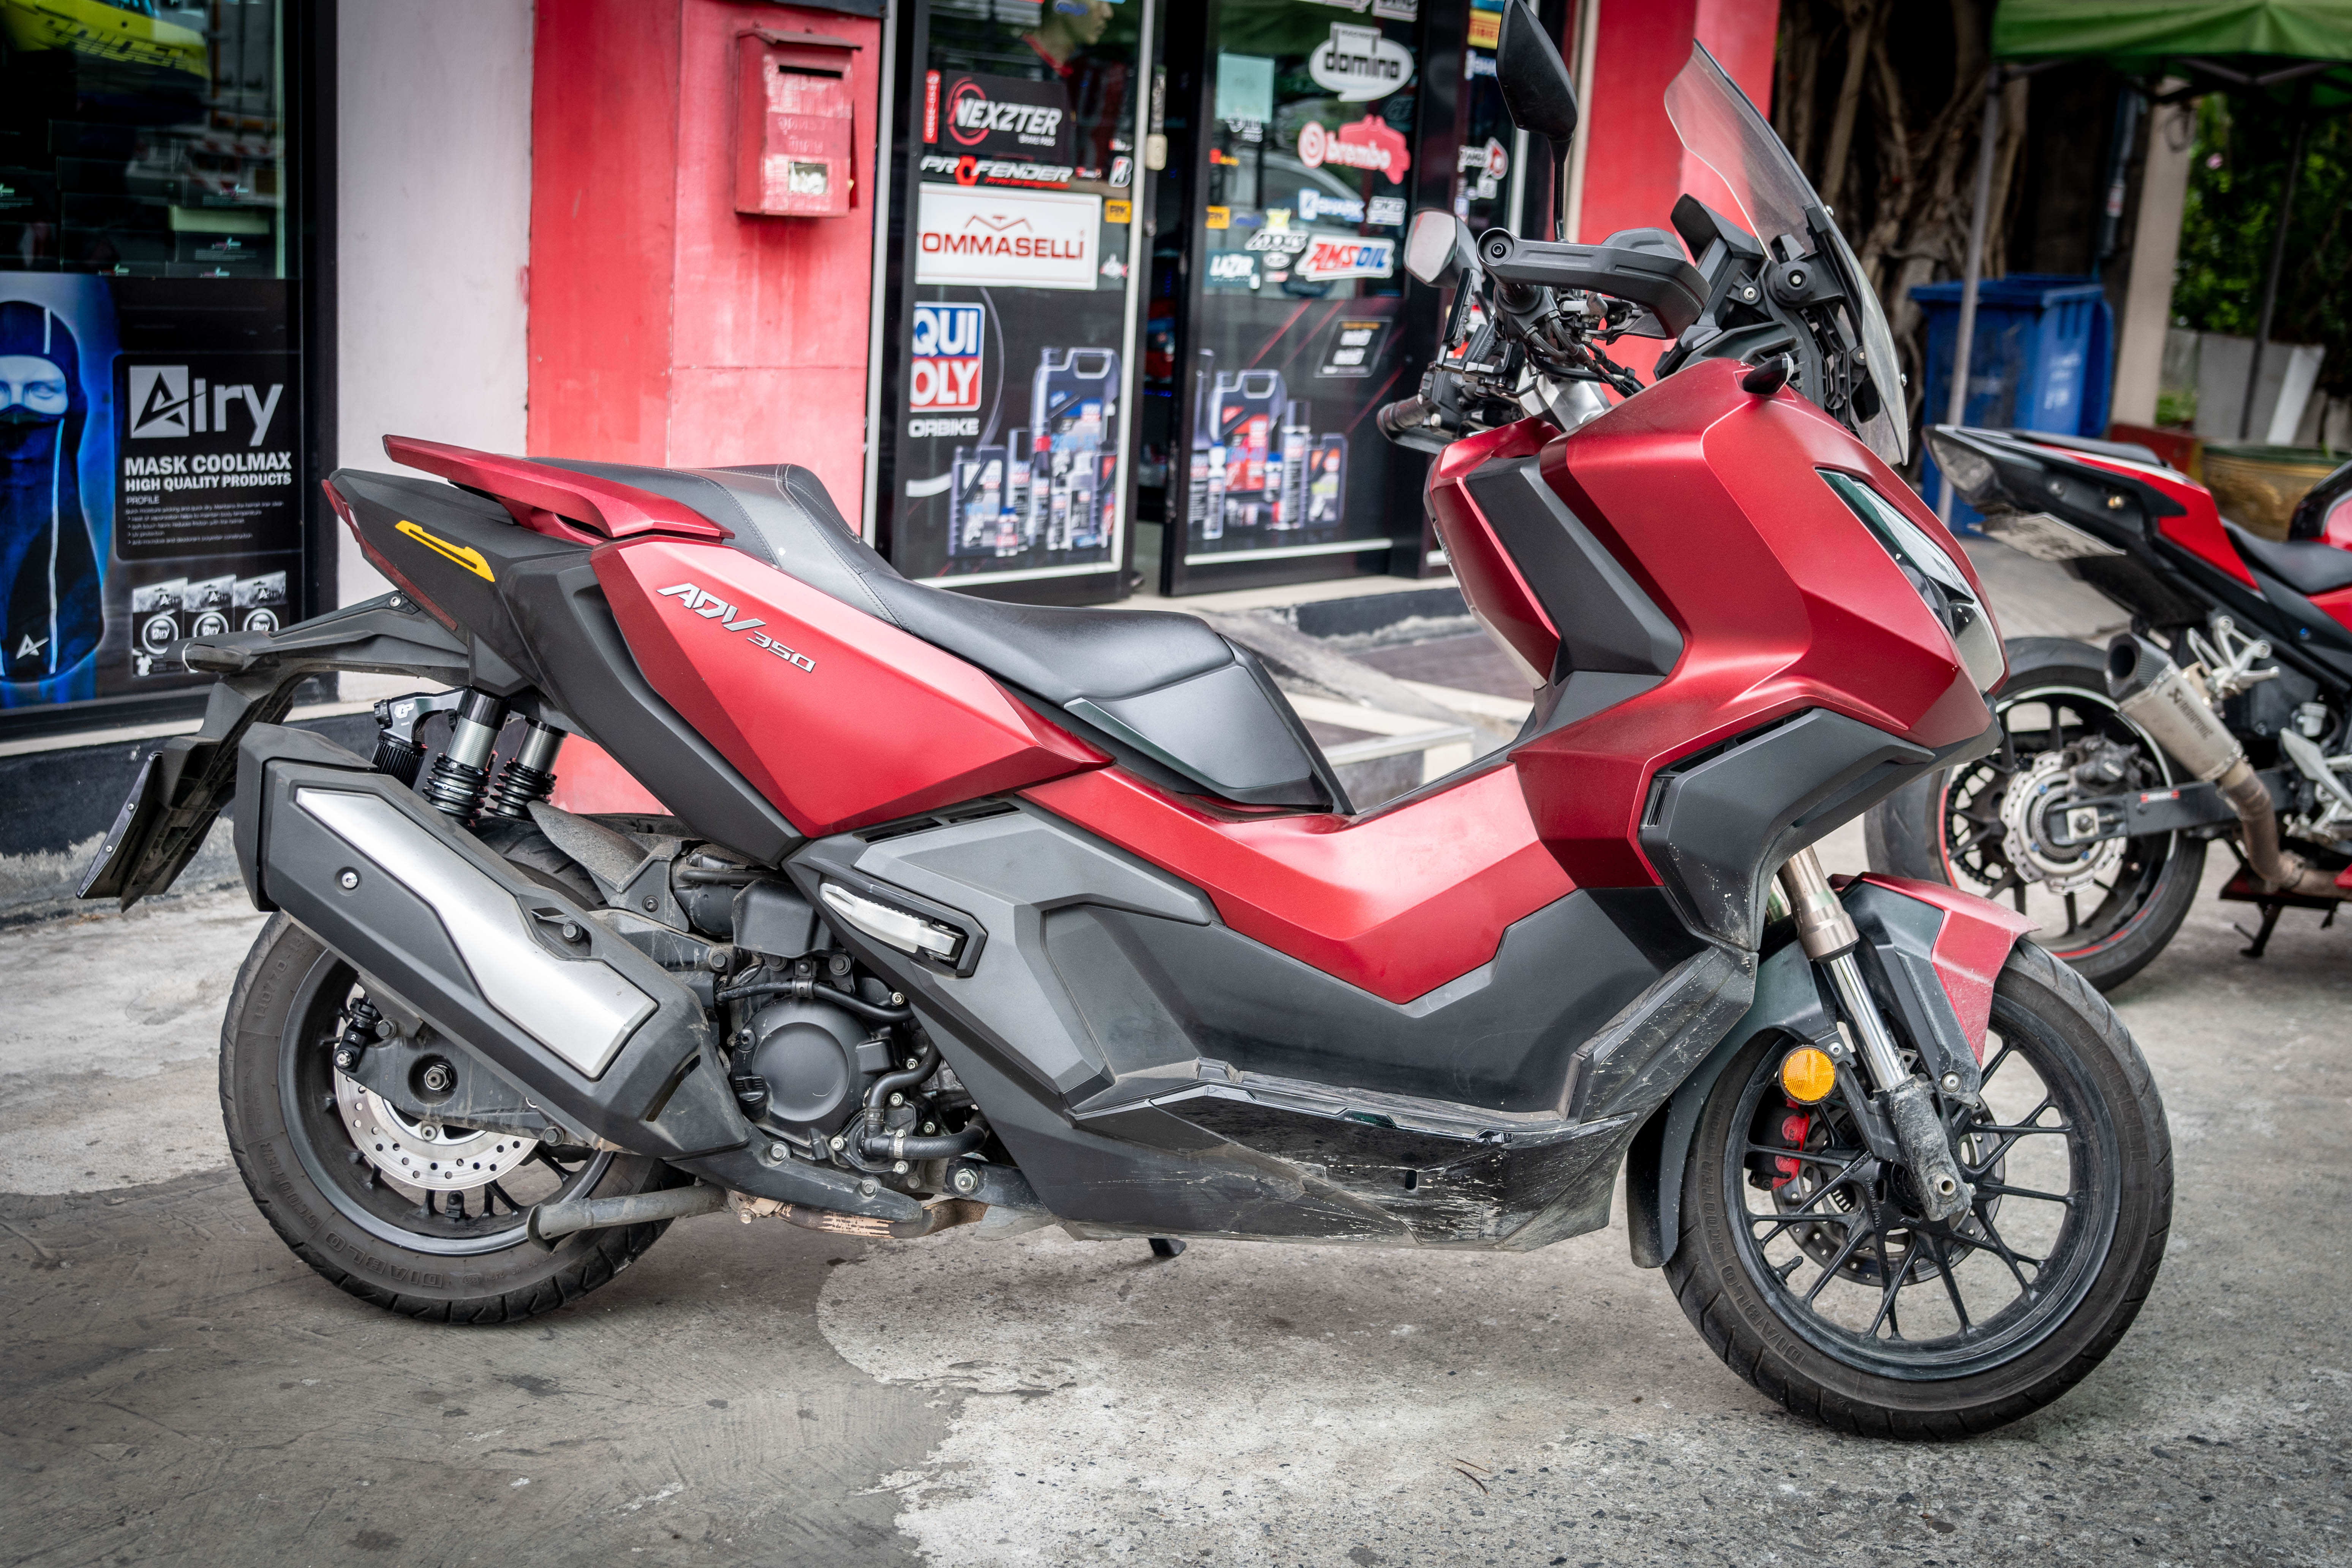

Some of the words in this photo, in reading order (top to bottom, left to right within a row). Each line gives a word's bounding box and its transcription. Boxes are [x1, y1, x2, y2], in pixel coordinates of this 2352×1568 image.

[1325, 31, 1400, 79] domino
[948, 97, 1062, 136] NEXZTER
[920, 155, 1073, 187] PROFENDER
[1326, 131, 1391, 170] brembo
[917, 232, 1084, 260] OMMASELLI
[1307, 243, 1388, 270] AMSOIL
[1476, 334, 1494, 363] OTOWOLF
[912, 360, 979, 405] OLY
[130, 365, 284, 447] Airy
[908, 418, 980, 437] ORBIKE
[124, 455, 188, 476] MASK
[191, 451, 292, 474] COOLMAX
[125, 477, 161, 492] HIGH
[163, 474, 220, 492] QUALITY
[221, 472, 292, 488] PRODUCTS
[126, 495, 160, 505] PROFILE
[656, 582, 766, 632] ADV
[747, 630, 816, 673] 350
[2066, 1016, 2148, 1162] PIRELLI
[259, 1141, 322, 1228] SCOOTER
[1701, 1160, 1727, 1254] SCOOTER
[326, 1231, 444, 1289] DIABLO
[1721, 1264, 1806, 1367] DIABLO
